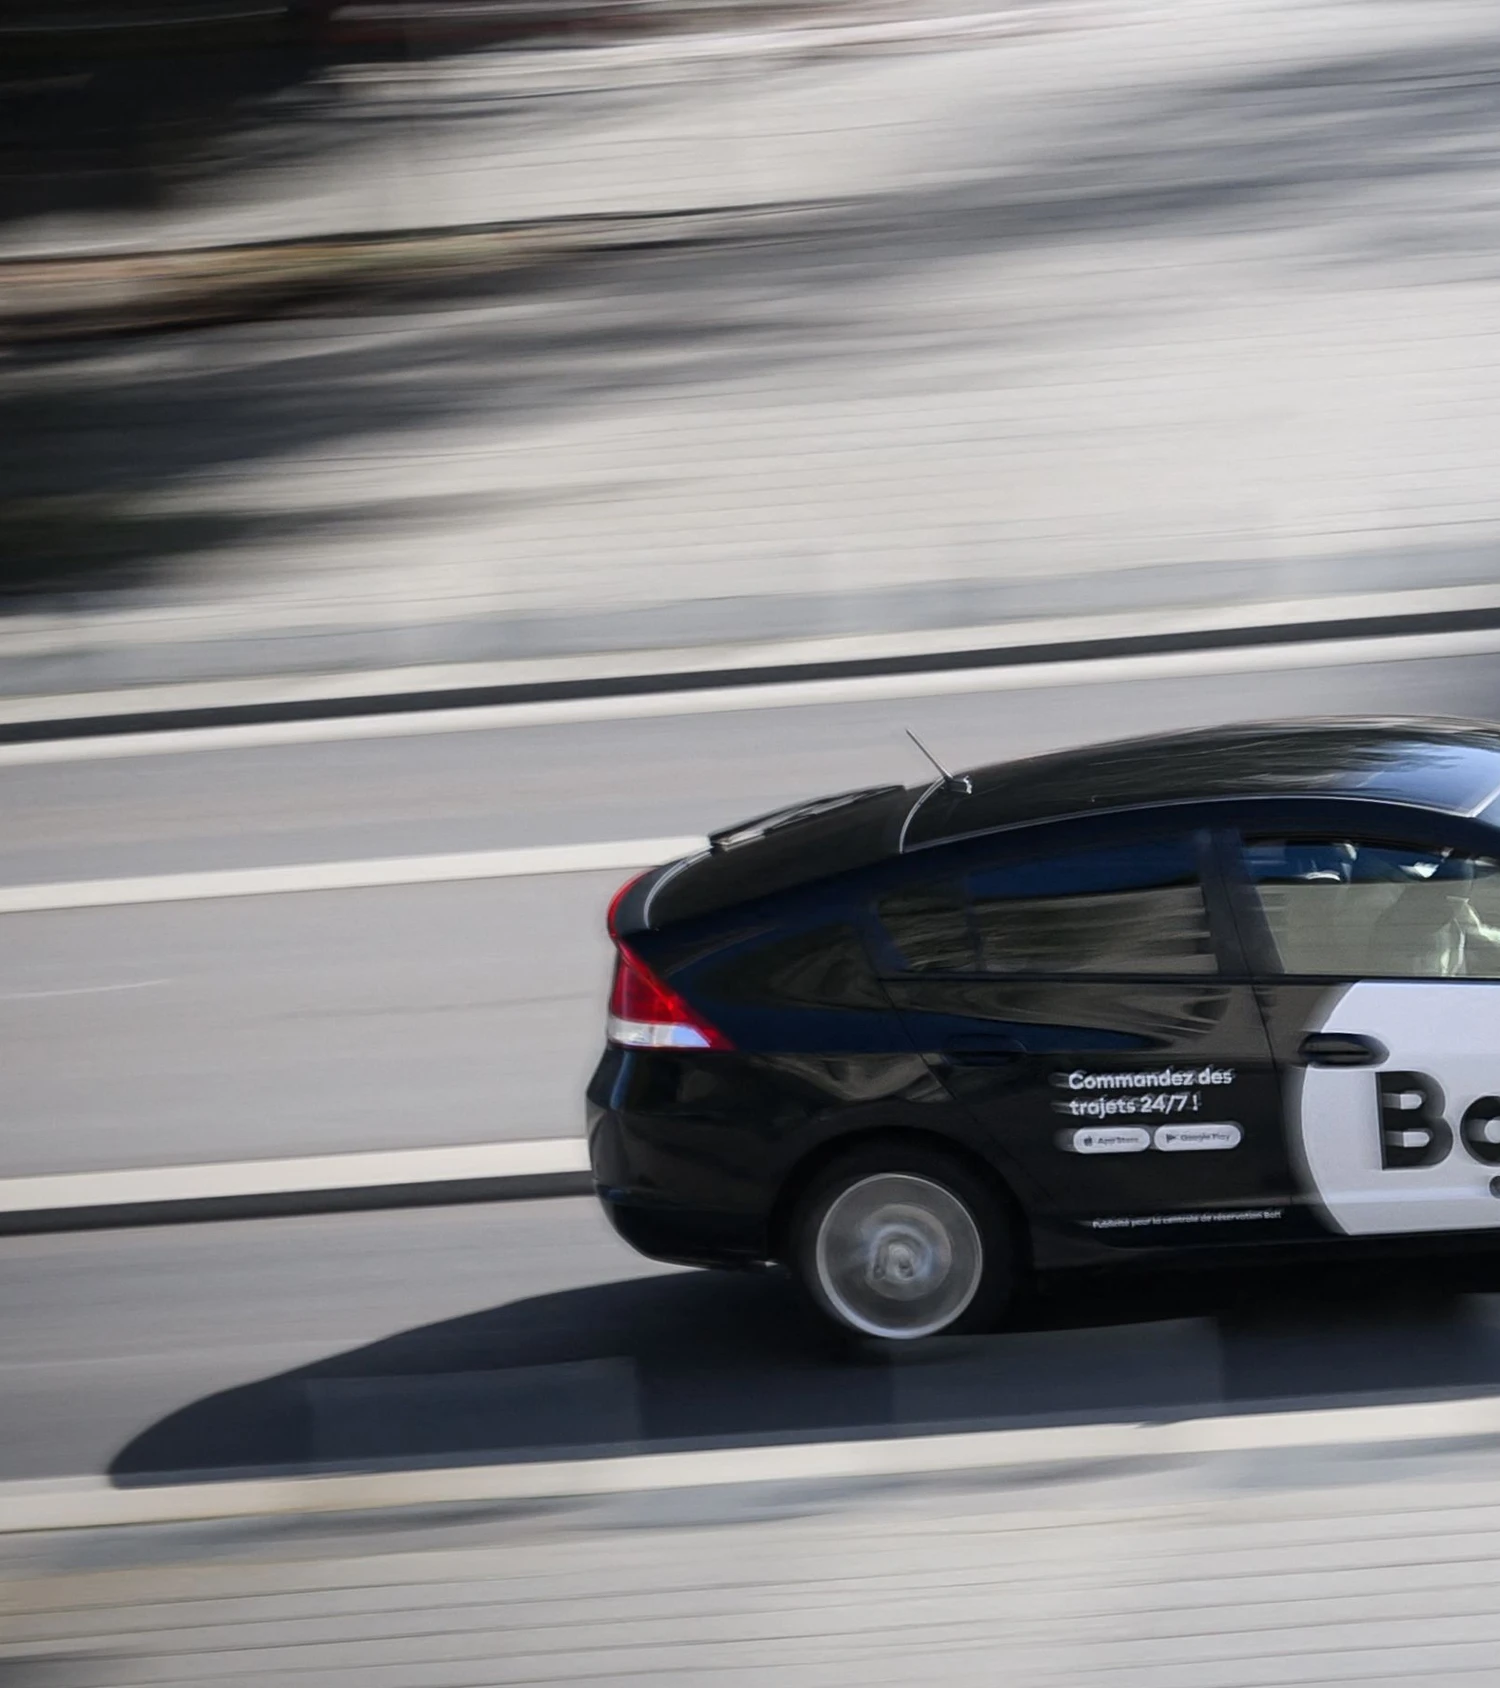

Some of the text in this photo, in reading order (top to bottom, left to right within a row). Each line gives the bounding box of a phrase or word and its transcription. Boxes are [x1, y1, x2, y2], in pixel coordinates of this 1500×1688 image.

[1068, 1066, 1233, 1089] Commandez des
[1069, 1097, 1136, 1118] trajets
[1140, 1095, 1188, 1114] 24/7
[1180, 1134, 1211, 1143] Google
